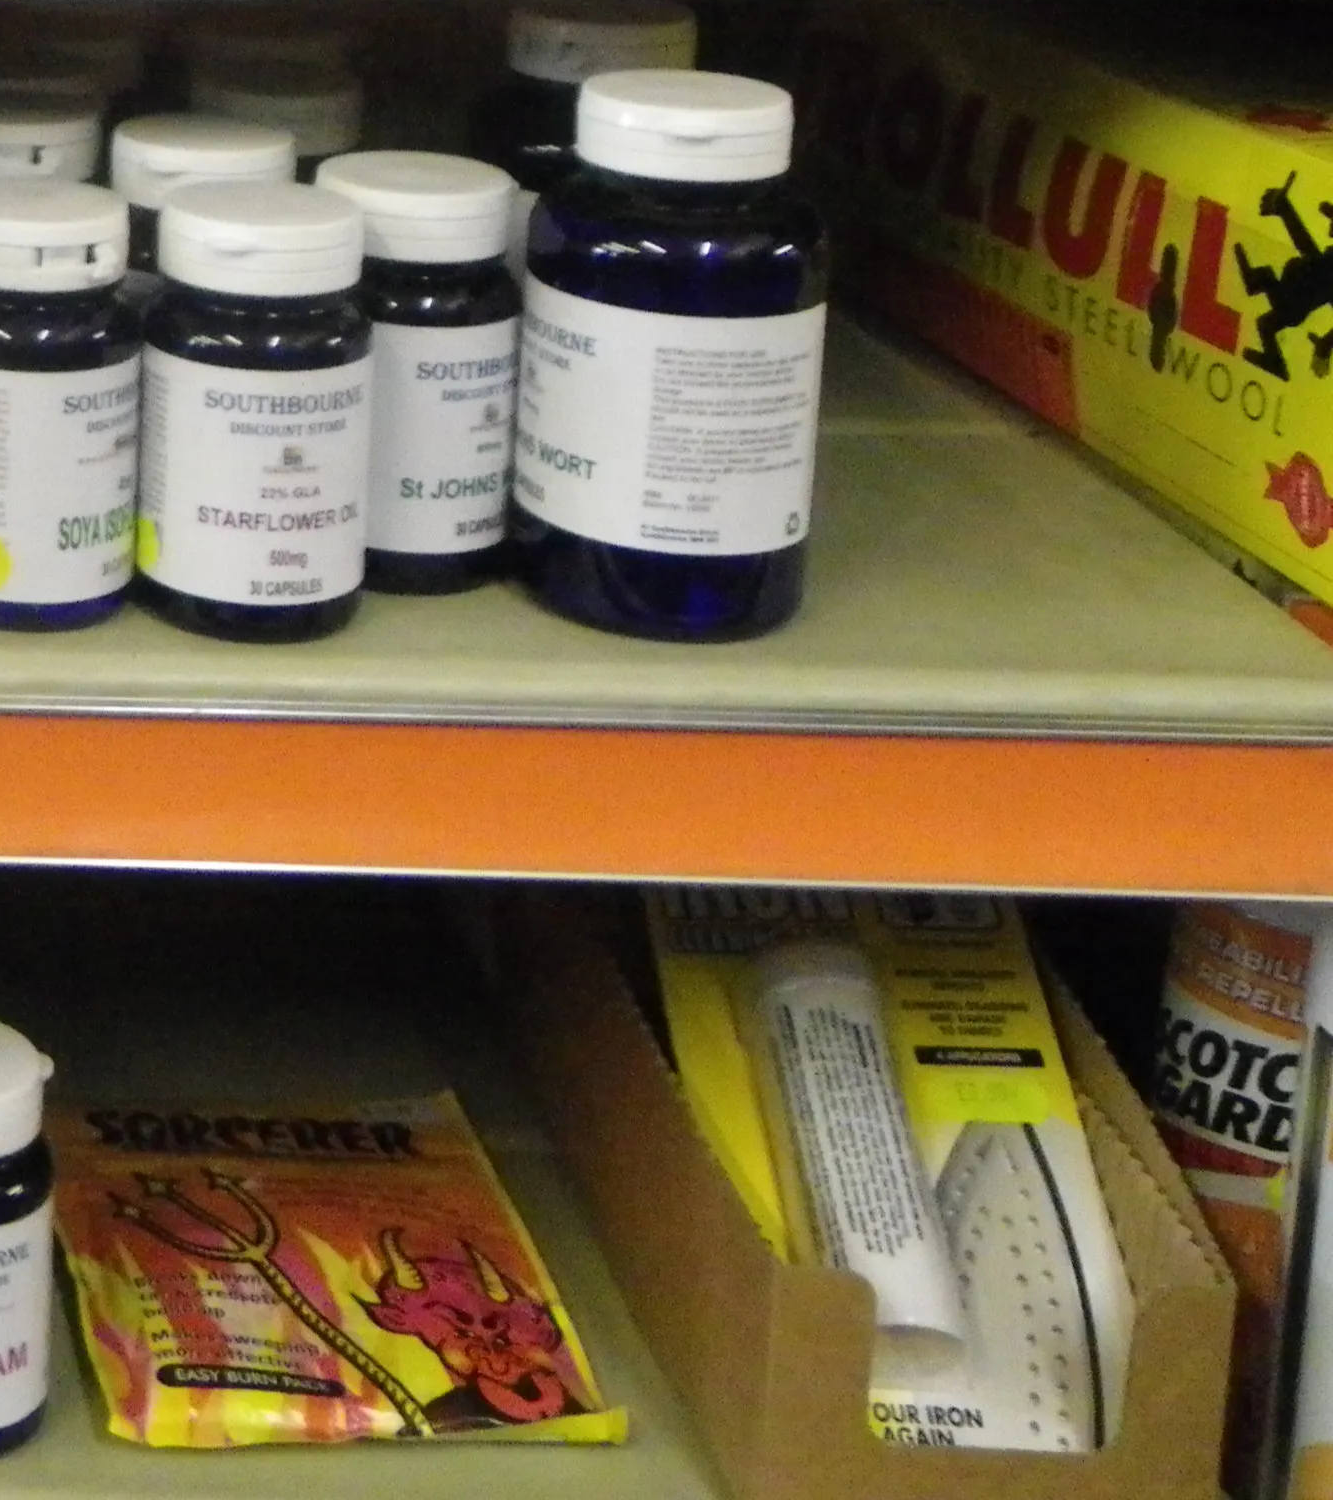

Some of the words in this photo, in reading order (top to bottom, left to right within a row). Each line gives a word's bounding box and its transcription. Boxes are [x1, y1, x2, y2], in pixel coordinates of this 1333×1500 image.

[1046, 277, 1139, 359] STEEL
[1167, 347, 1288, 438] WOOL
[204, 384, 363, 416] SOUTHBOURNE
[539, 445, 597, 481] WORT
[400, 477, 423, 500] St
[429, 475, 498, 500] JOHNS
[58, 514, 99, 551] SOYA
[197, 505, 338, 532] STARFLOWER
[264, 579, 322, 596] CAPSULES
[1154, 1063, 1295, 1152] GARD
[87, 1111, 413, 1157] SORCERER
[175, 1364, 219, 1382] EASY
[927, 1406, 984, 1428] IRON
[884, 1426, 956, 1446] AGAIN
